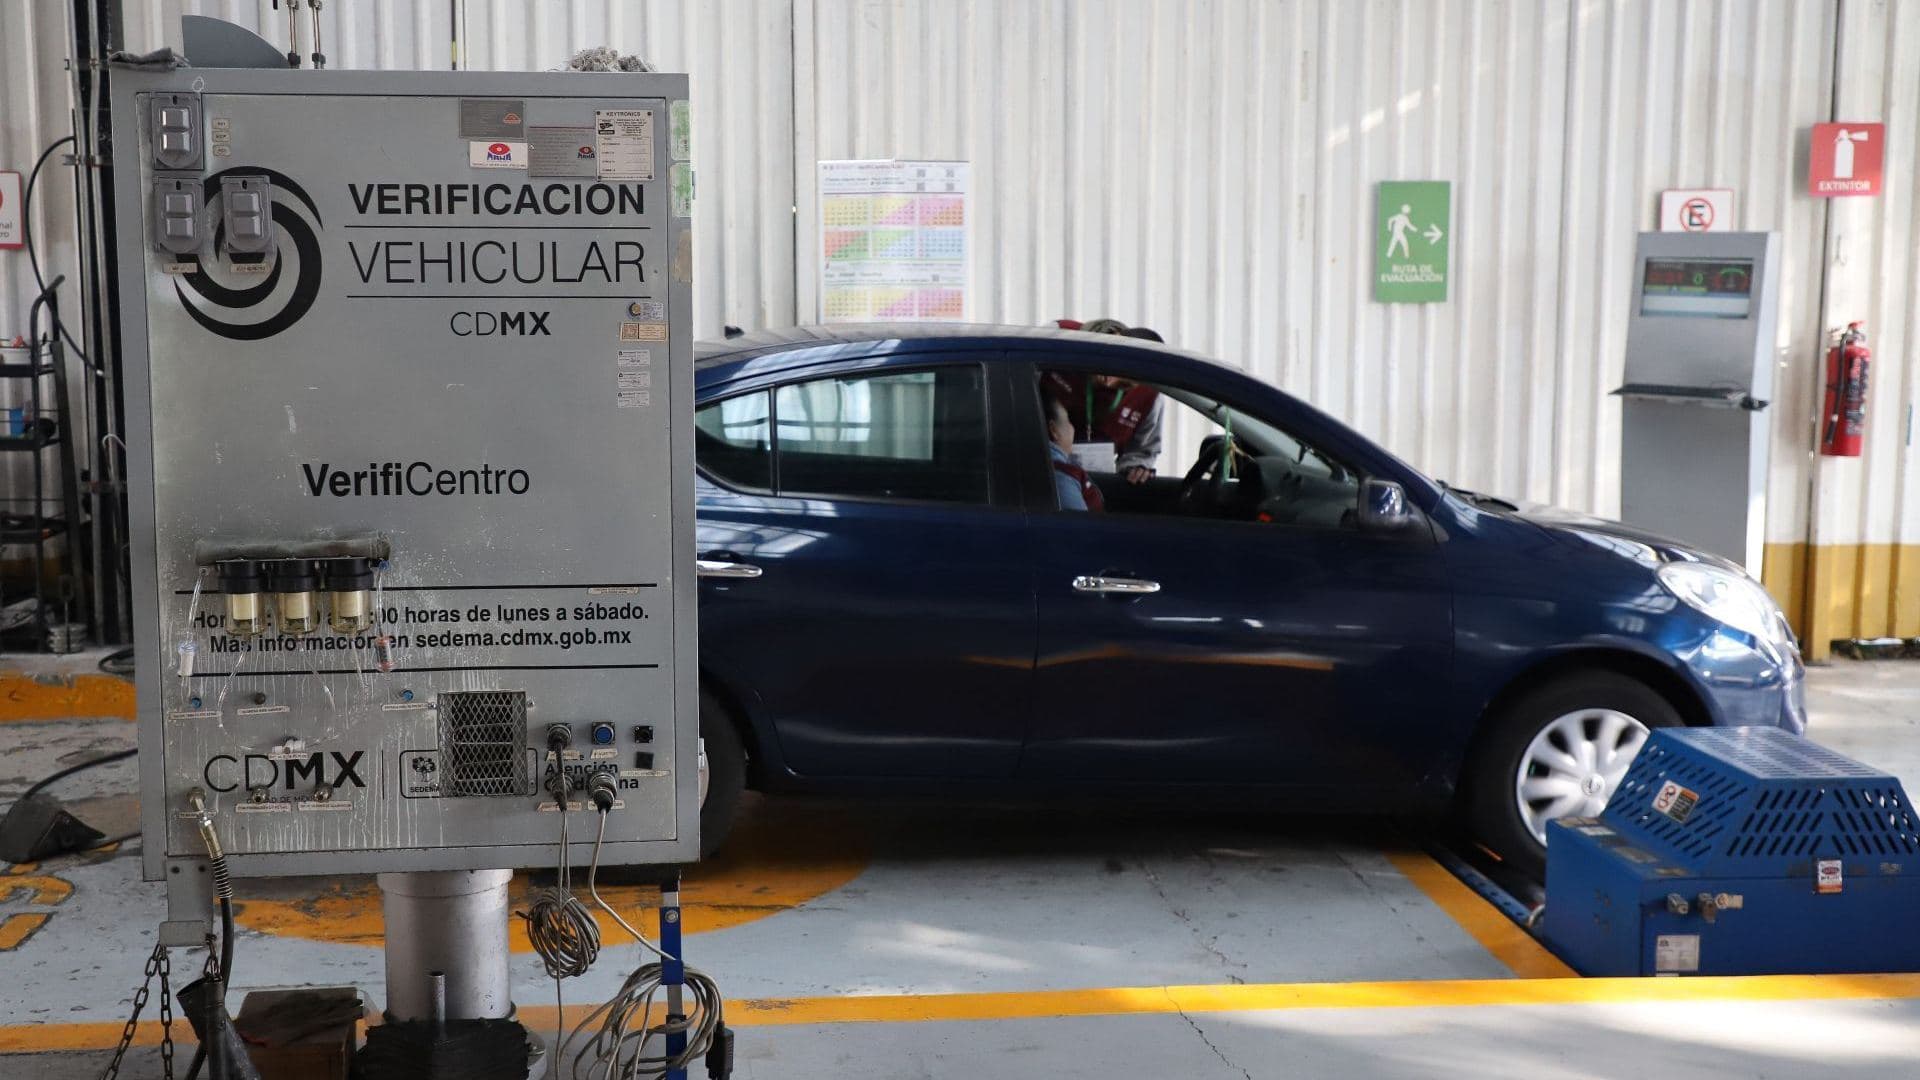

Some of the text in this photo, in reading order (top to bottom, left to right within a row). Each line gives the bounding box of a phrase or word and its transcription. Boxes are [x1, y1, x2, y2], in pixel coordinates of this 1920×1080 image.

[1818, 180, 1871, 191] EXTINTOR
[348, 240, 645, 284] VEHICULAR
[1391, 264, 1417, 273] RUTA
[450, 311, 551, 337] CDMX
[302, 461, 530, 497] VerifiCentro
[405, 606, 460, 623] horas
[467, 605, 491, 622] de
[498, 604, 550, 622] lunes
[556, 606, 568, 620] a
[573, 602, 649, 621] sábado.
[416, 628, 632, 649] sedema.cdmx.gob.mx
[204, 751, 366, 793] CDMX
[545, 760, 618, 776] Aención
